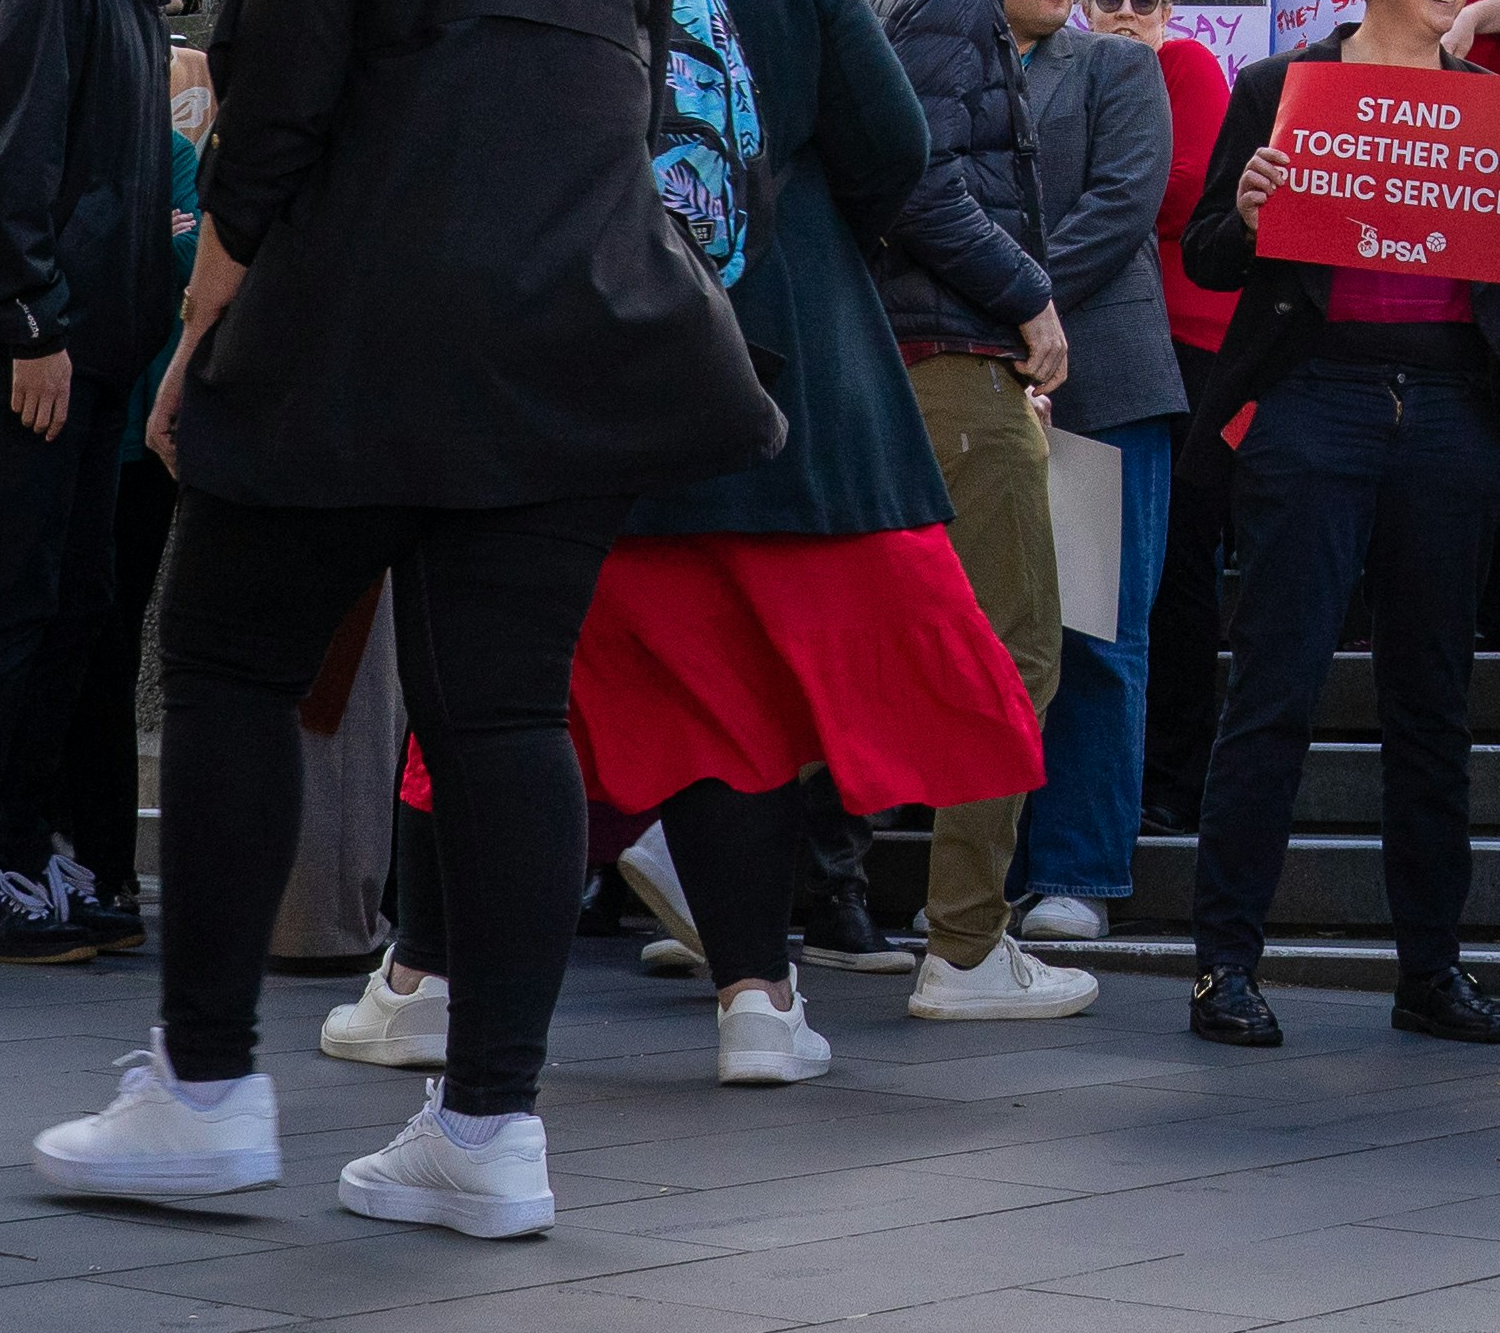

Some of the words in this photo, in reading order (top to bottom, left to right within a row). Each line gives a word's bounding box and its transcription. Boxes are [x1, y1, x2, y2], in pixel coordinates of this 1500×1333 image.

[1167, 14, 1242, 45] SAY
[1357, 97, 1461, 130] STAND
[1293, 129, 1449, 169] TOGETHER
[1276, 166, 1376, 200] PUBLIC
[1381, 239, 1426, 263] PSA
